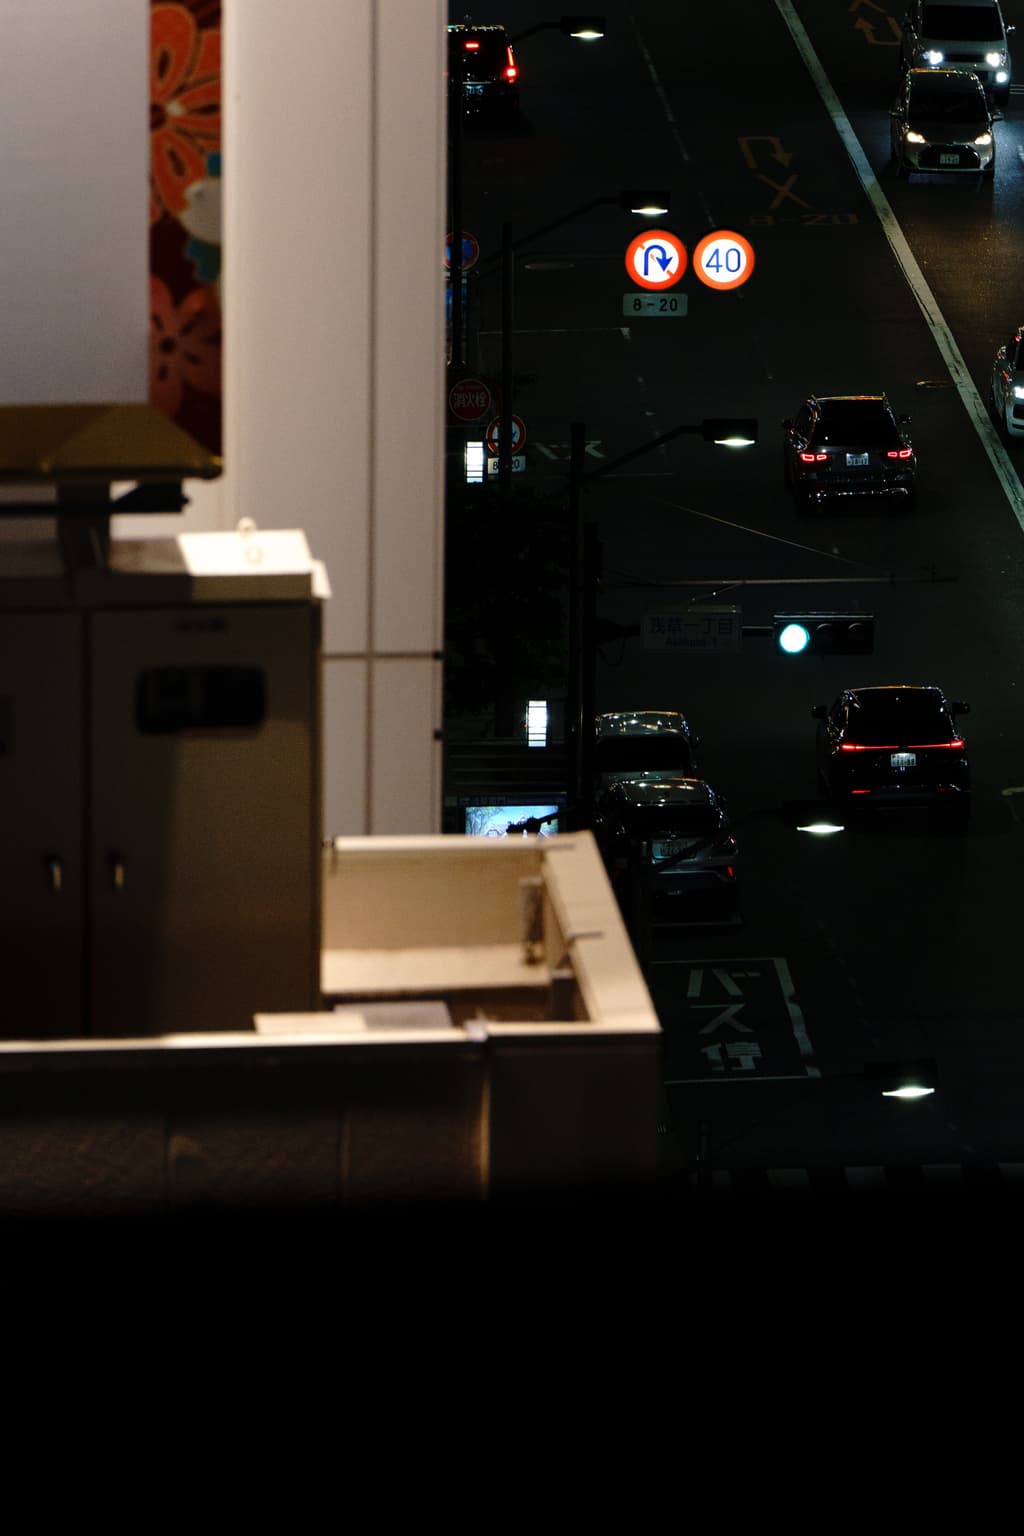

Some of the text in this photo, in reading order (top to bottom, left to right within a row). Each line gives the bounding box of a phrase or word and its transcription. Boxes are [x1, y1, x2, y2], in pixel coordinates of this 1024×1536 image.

[705, 248, 741, 272] 40
[633, 298, 678, 312] 8-20
[453, 392, 488, 409] 消火栓
[686, 968, 764, 1072] バス停
